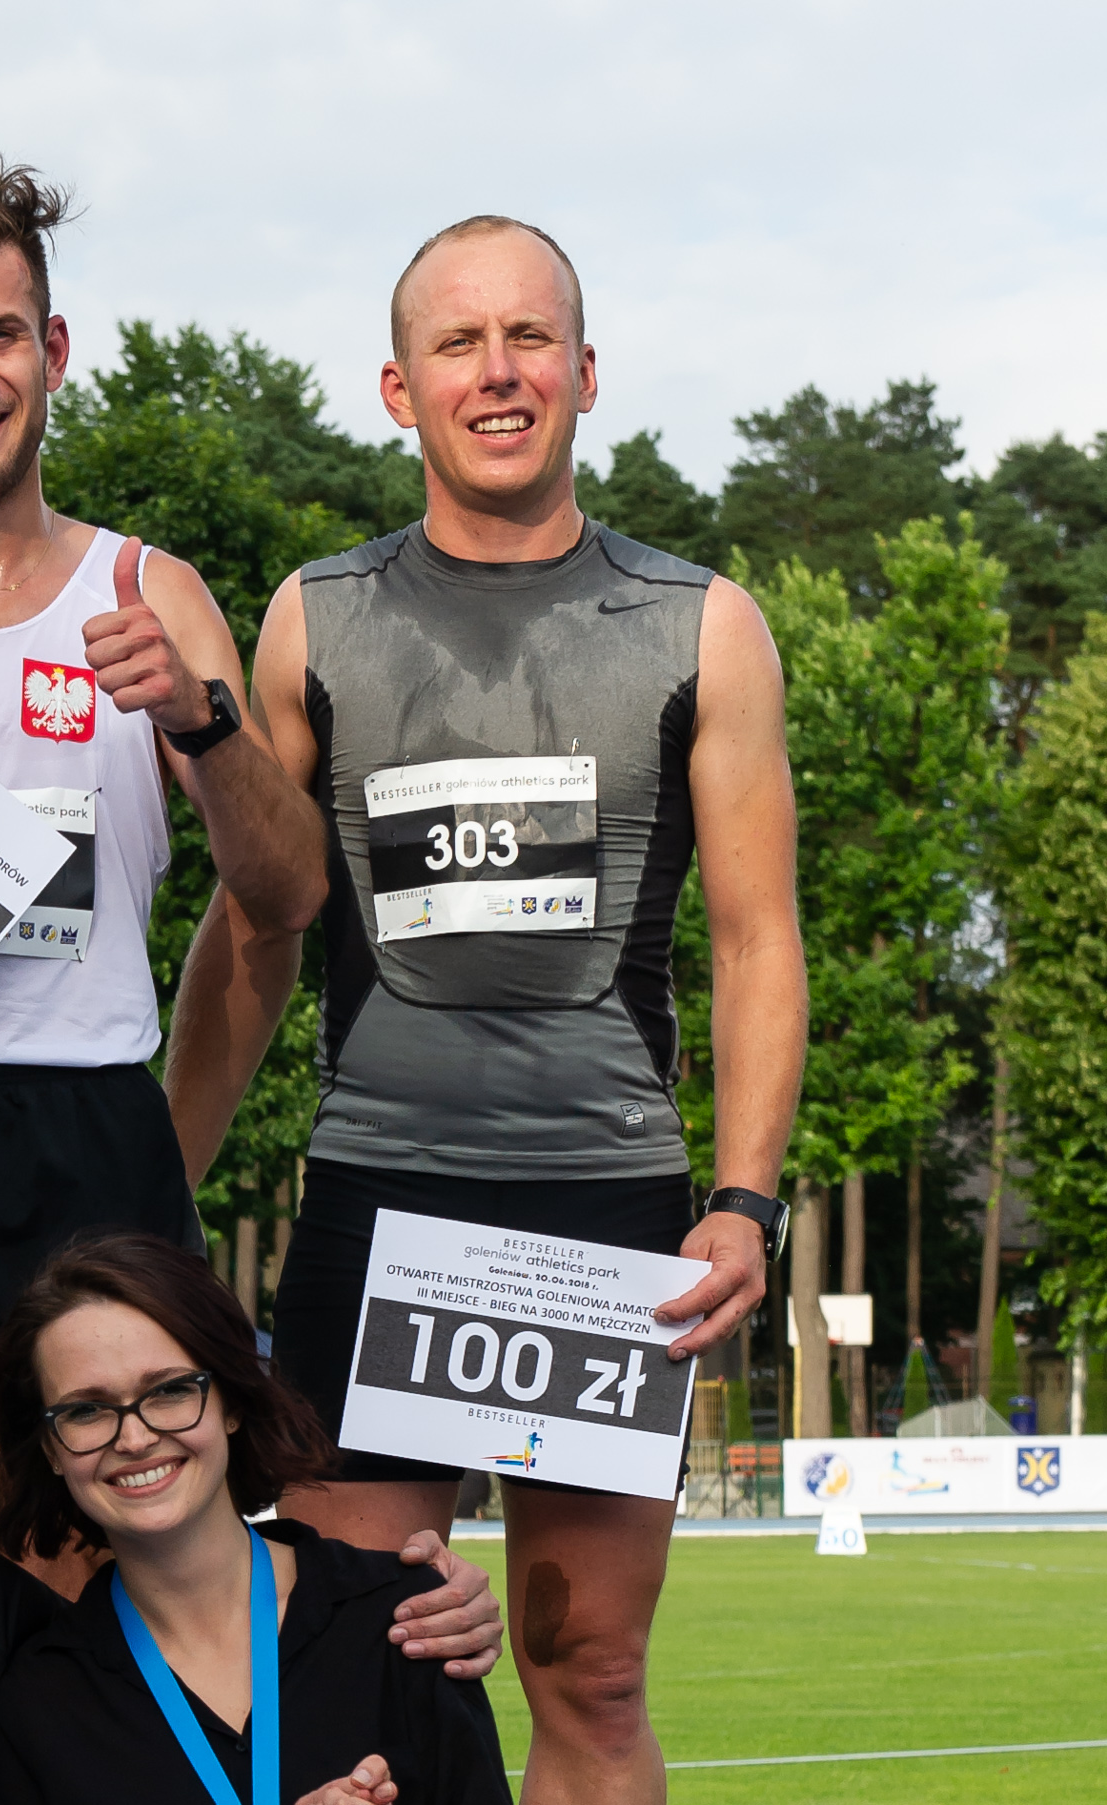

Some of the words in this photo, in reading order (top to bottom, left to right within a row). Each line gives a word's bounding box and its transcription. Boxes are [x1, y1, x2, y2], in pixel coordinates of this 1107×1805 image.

[373, 782, 442, 801] BESTSELLER
[446, 777, 497, 793] goleniów
[501, 775, 555, 788] athletics
[559, 775, 590, 789] park
[59, 807, 89, 819] park
[425, 820, 519, 870] 303
[386, 888, 432, 902] BESTSELLER
[503, 1238, 584, 1260] BESTSELLER
[464, 1246, 521, 1262] goleniów
[526, 1256, 584, 1274] athletics
[587, 1267, 620, 1280] park
[387, 1264, 444, 1283] OTWARTE
[446, 1274, 533, 1298] MISTRZOSTWA
[537, 1289, 610, 1310] GOLENIOWA
[535, 1273, 590, 1289] 20.06.2018
[417, 1287, 428, 1298] III
[431, 1289, 480, 1306] MIEJSCE
[490, 1299, 517, 1313] BIEG
[520, 1304, 537, 1316] NA
[541, 1307, 569, 1321] 3000
[572, 1313, 585, 1324] M
[588, 1315, 651, 1334] MĘŻCZYZN
[409, 1313, 553, 1401] 100
[576, 1349, 647, 1417] zł
[468, 1407, 545, 1428] BESTSELLER
